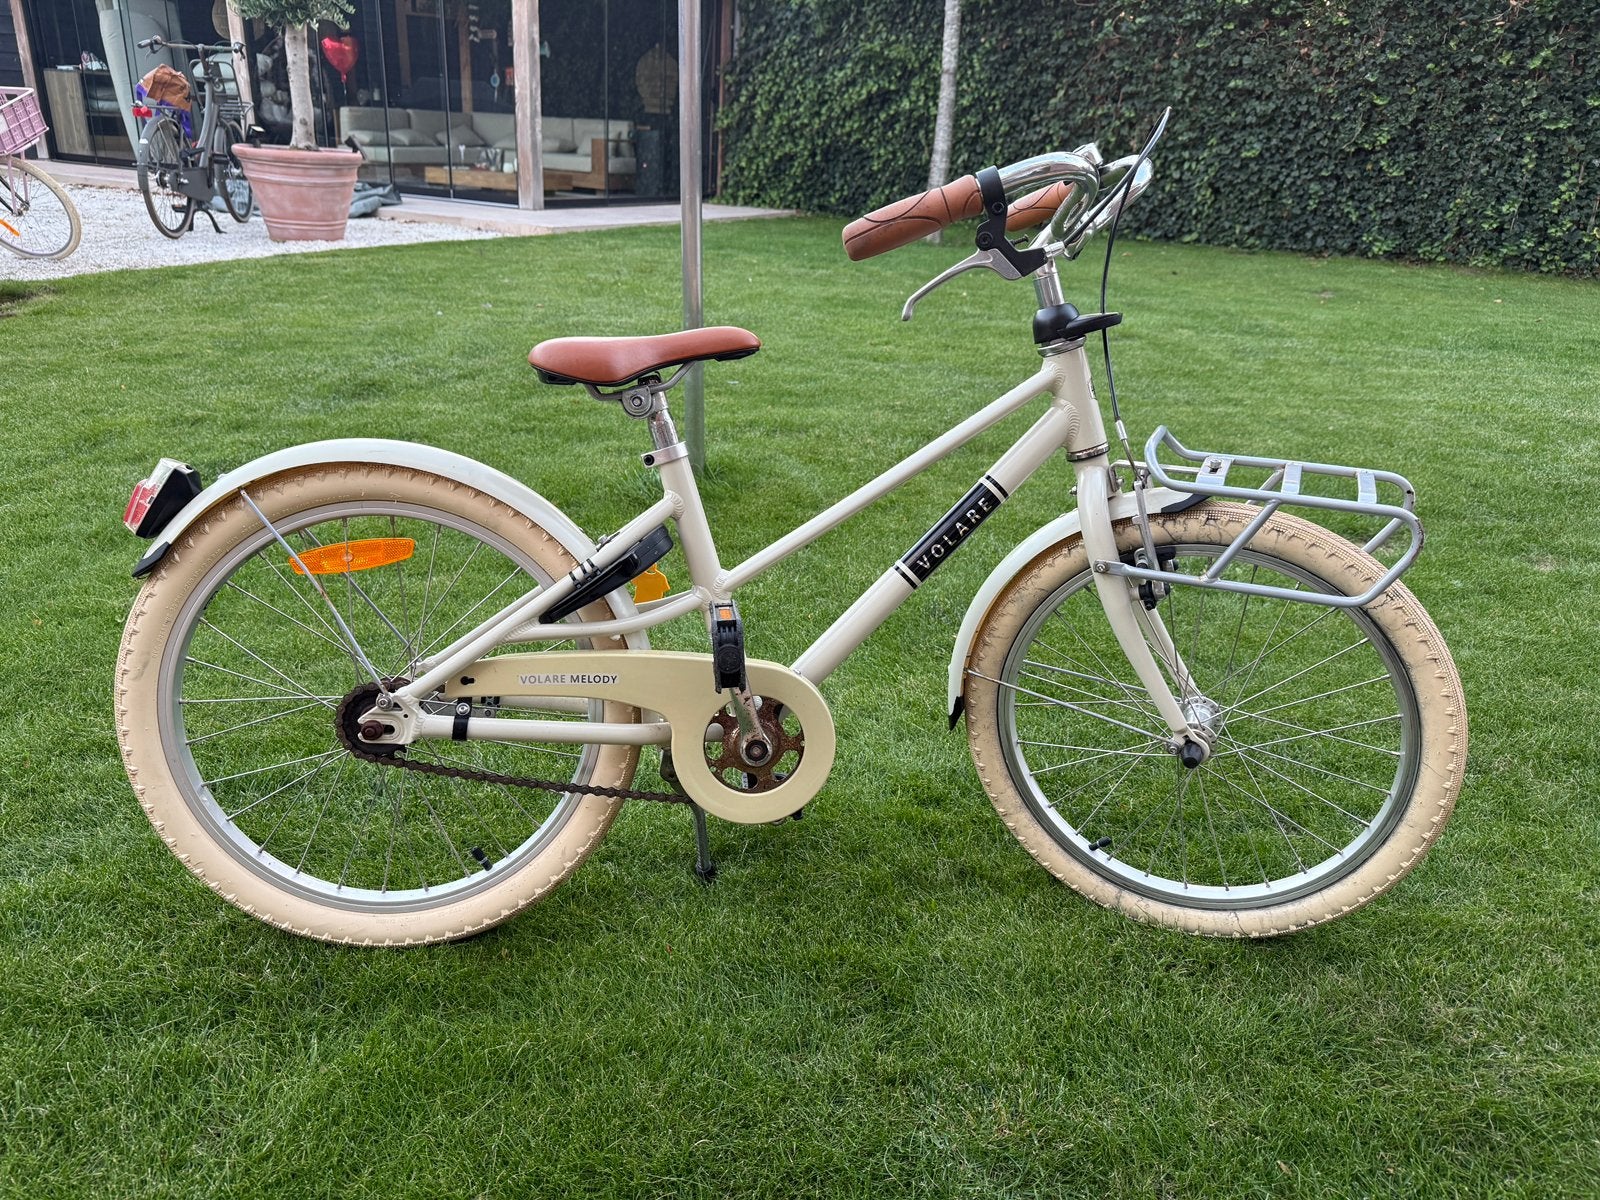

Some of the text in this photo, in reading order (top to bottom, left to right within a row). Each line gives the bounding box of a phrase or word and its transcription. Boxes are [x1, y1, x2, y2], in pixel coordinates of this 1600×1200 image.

[917, 497, 992, 570] VOLARE
[520, 674, 617, 684] VOLARE MELODY
